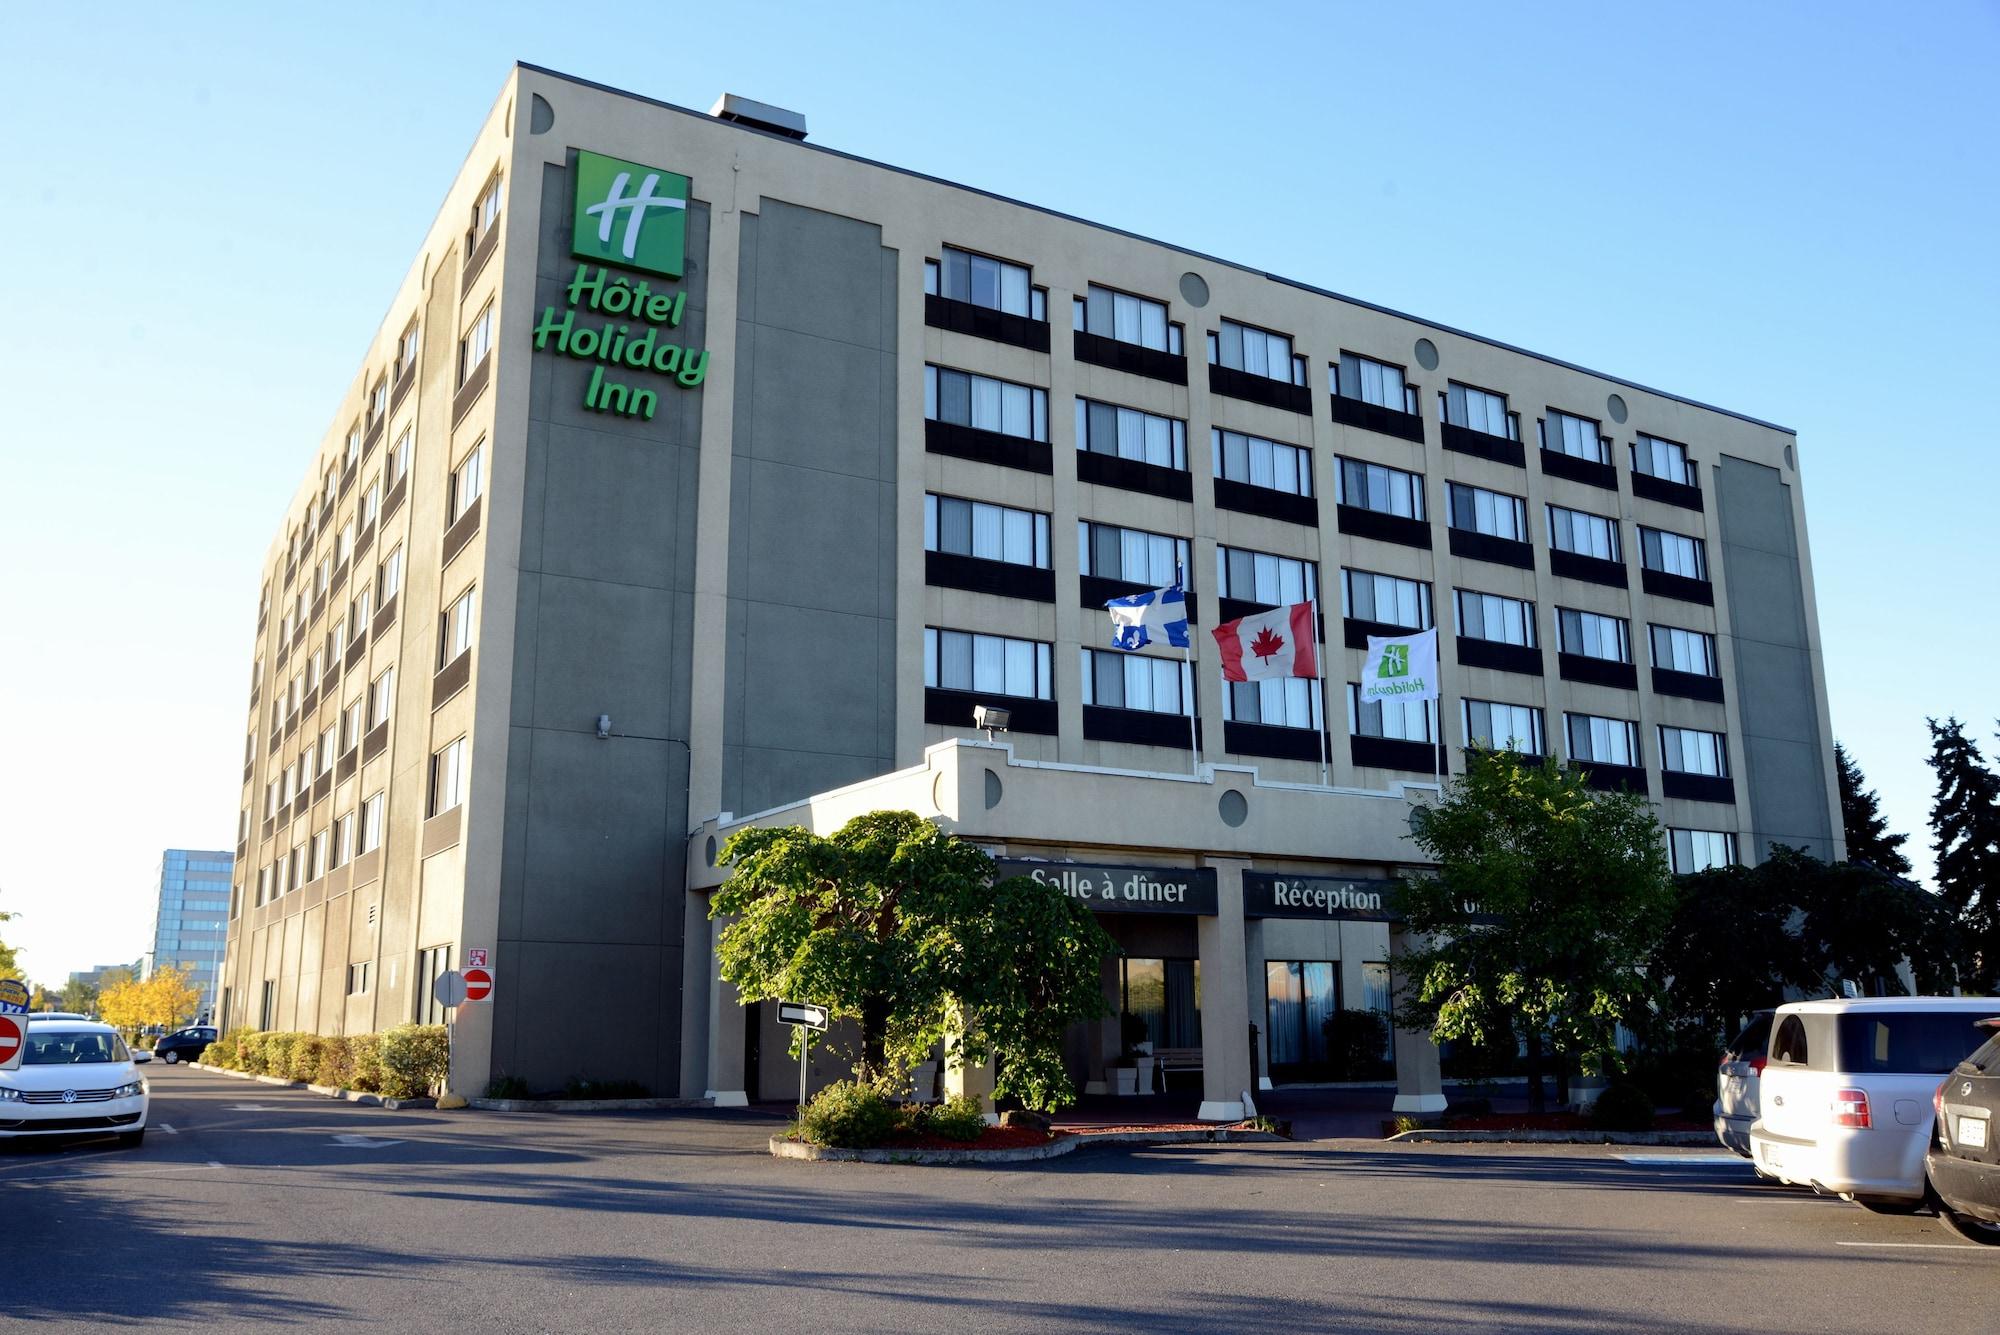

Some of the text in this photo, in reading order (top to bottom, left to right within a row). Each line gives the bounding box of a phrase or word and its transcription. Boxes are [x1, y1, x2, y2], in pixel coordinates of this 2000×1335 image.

[567, 263, 687, 328] Hôtel
[532, 306, 710, 390] Holiday
[583, 365, 658, 420] Inn
[1101, 872, 1116, 900] à
[1123, 874, 1188, 902] dîner
[1273, 881, 1381, 914] Réception
